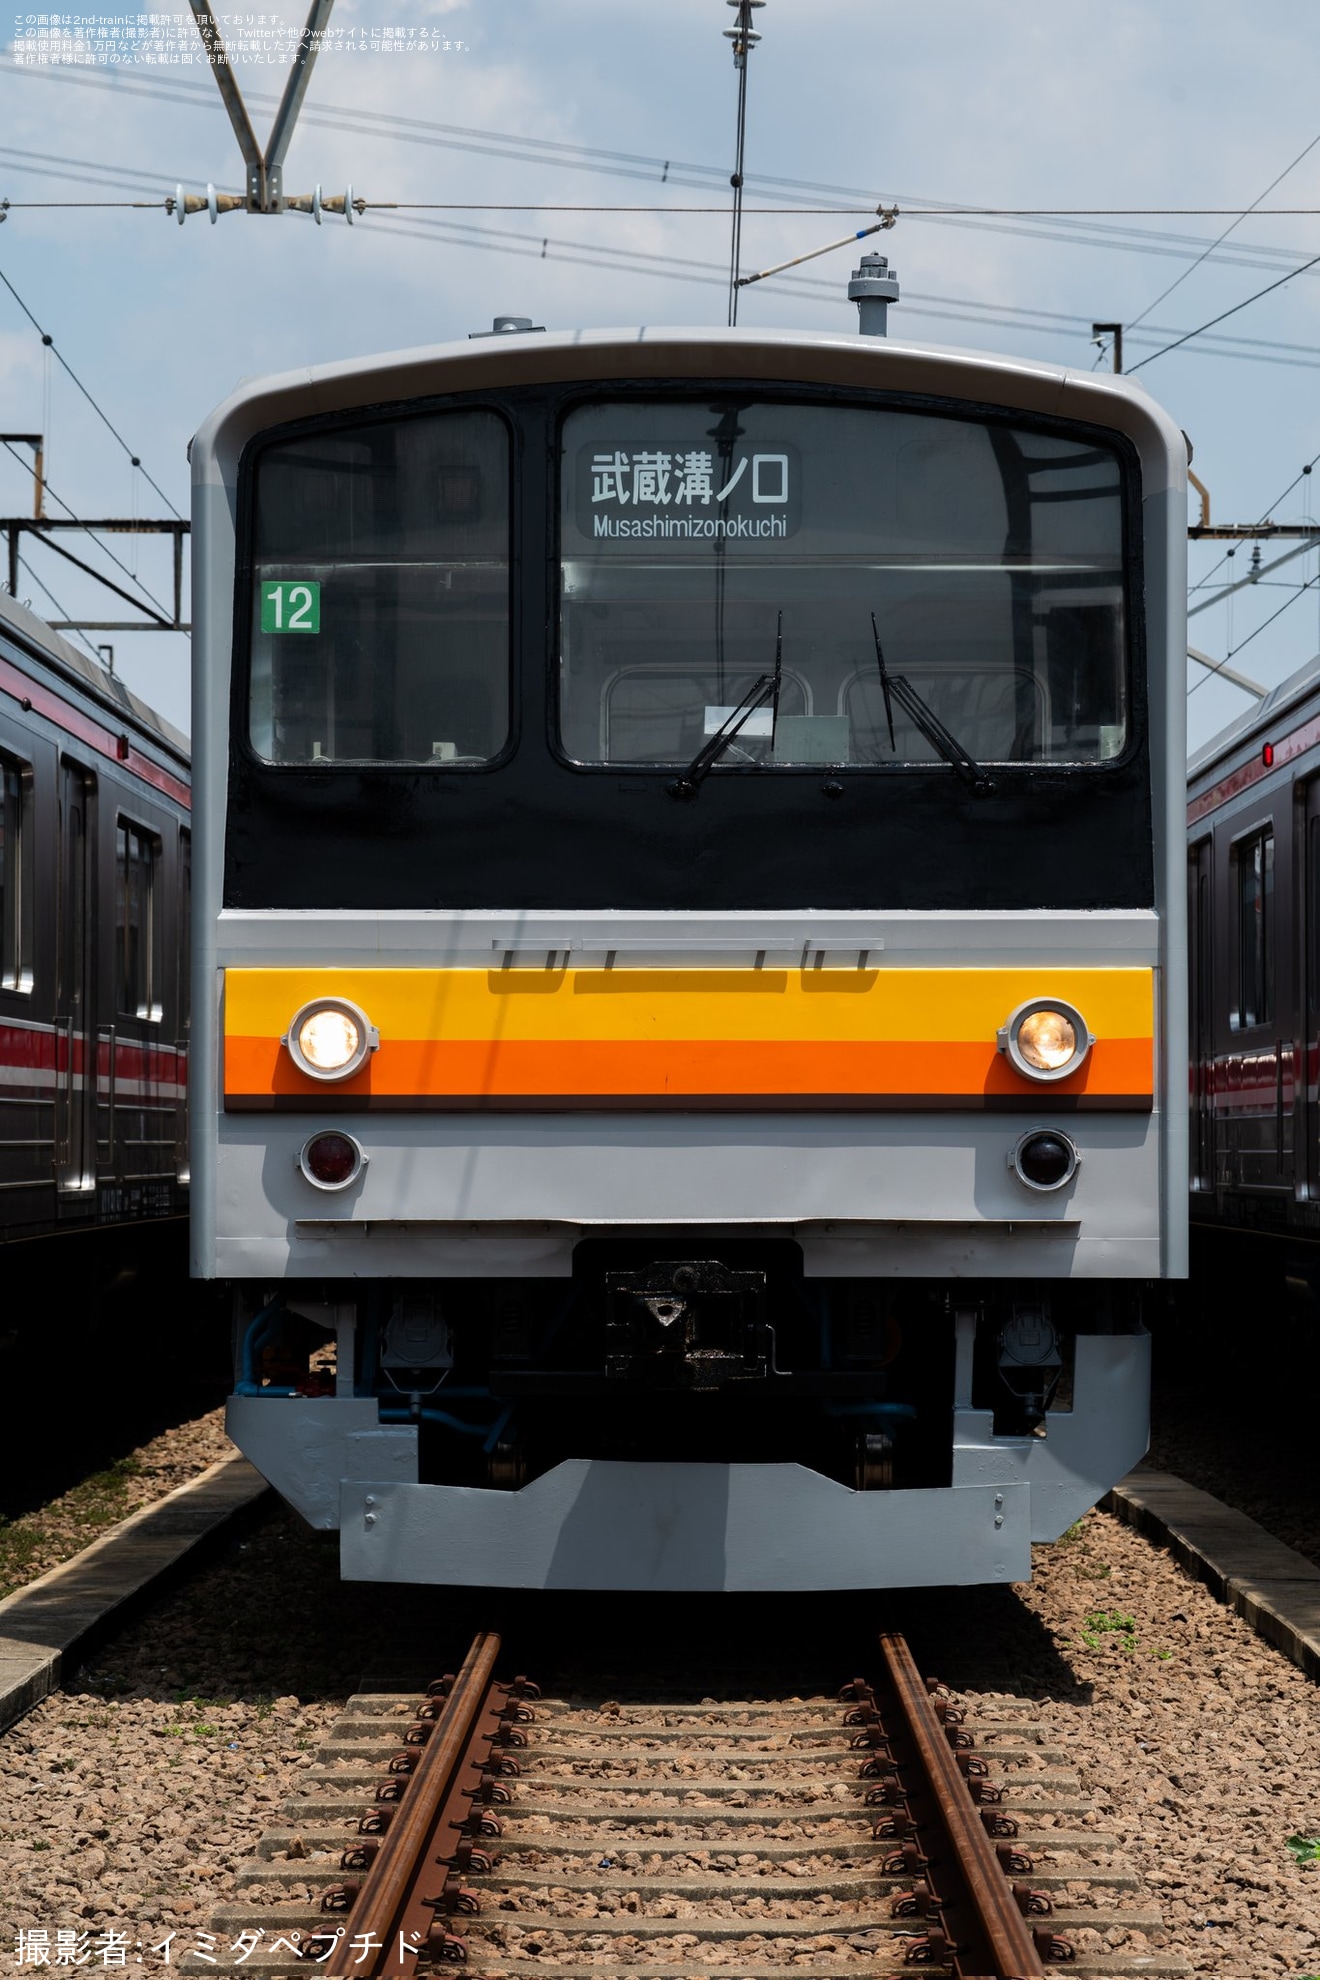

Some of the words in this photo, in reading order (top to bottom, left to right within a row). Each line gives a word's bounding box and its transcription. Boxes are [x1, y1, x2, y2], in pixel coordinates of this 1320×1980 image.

[591, 451, 789, 505] 武蔵溝ノ口
[593, 514, 787, 538] Musashimizonokuchi
[267, 586, 313, 629] 12
